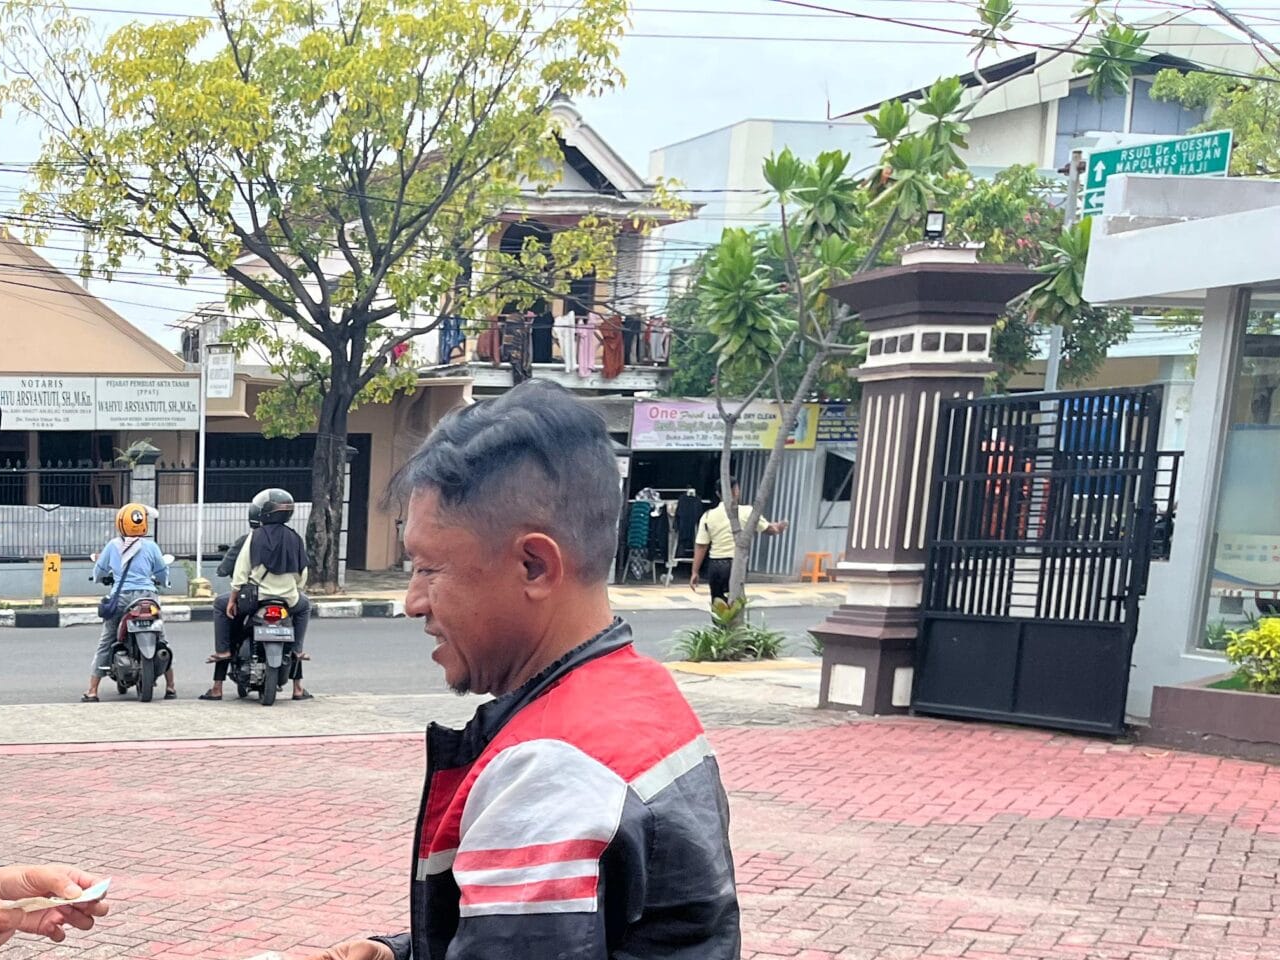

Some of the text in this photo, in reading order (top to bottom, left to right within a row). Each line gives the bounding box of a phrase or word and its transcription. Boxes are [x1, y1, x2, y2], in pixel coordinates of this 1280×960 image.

[1175, 136, 1219, 153] KOESMA
[1182, 148, 1221, 163] TUBAN
[1179, 161, 1208, 175] HAJI
[21, 379, 63, 388] NOTARIS
[98, 401, 123, 412] WAHYU
[649, 406, 678, 419] One
